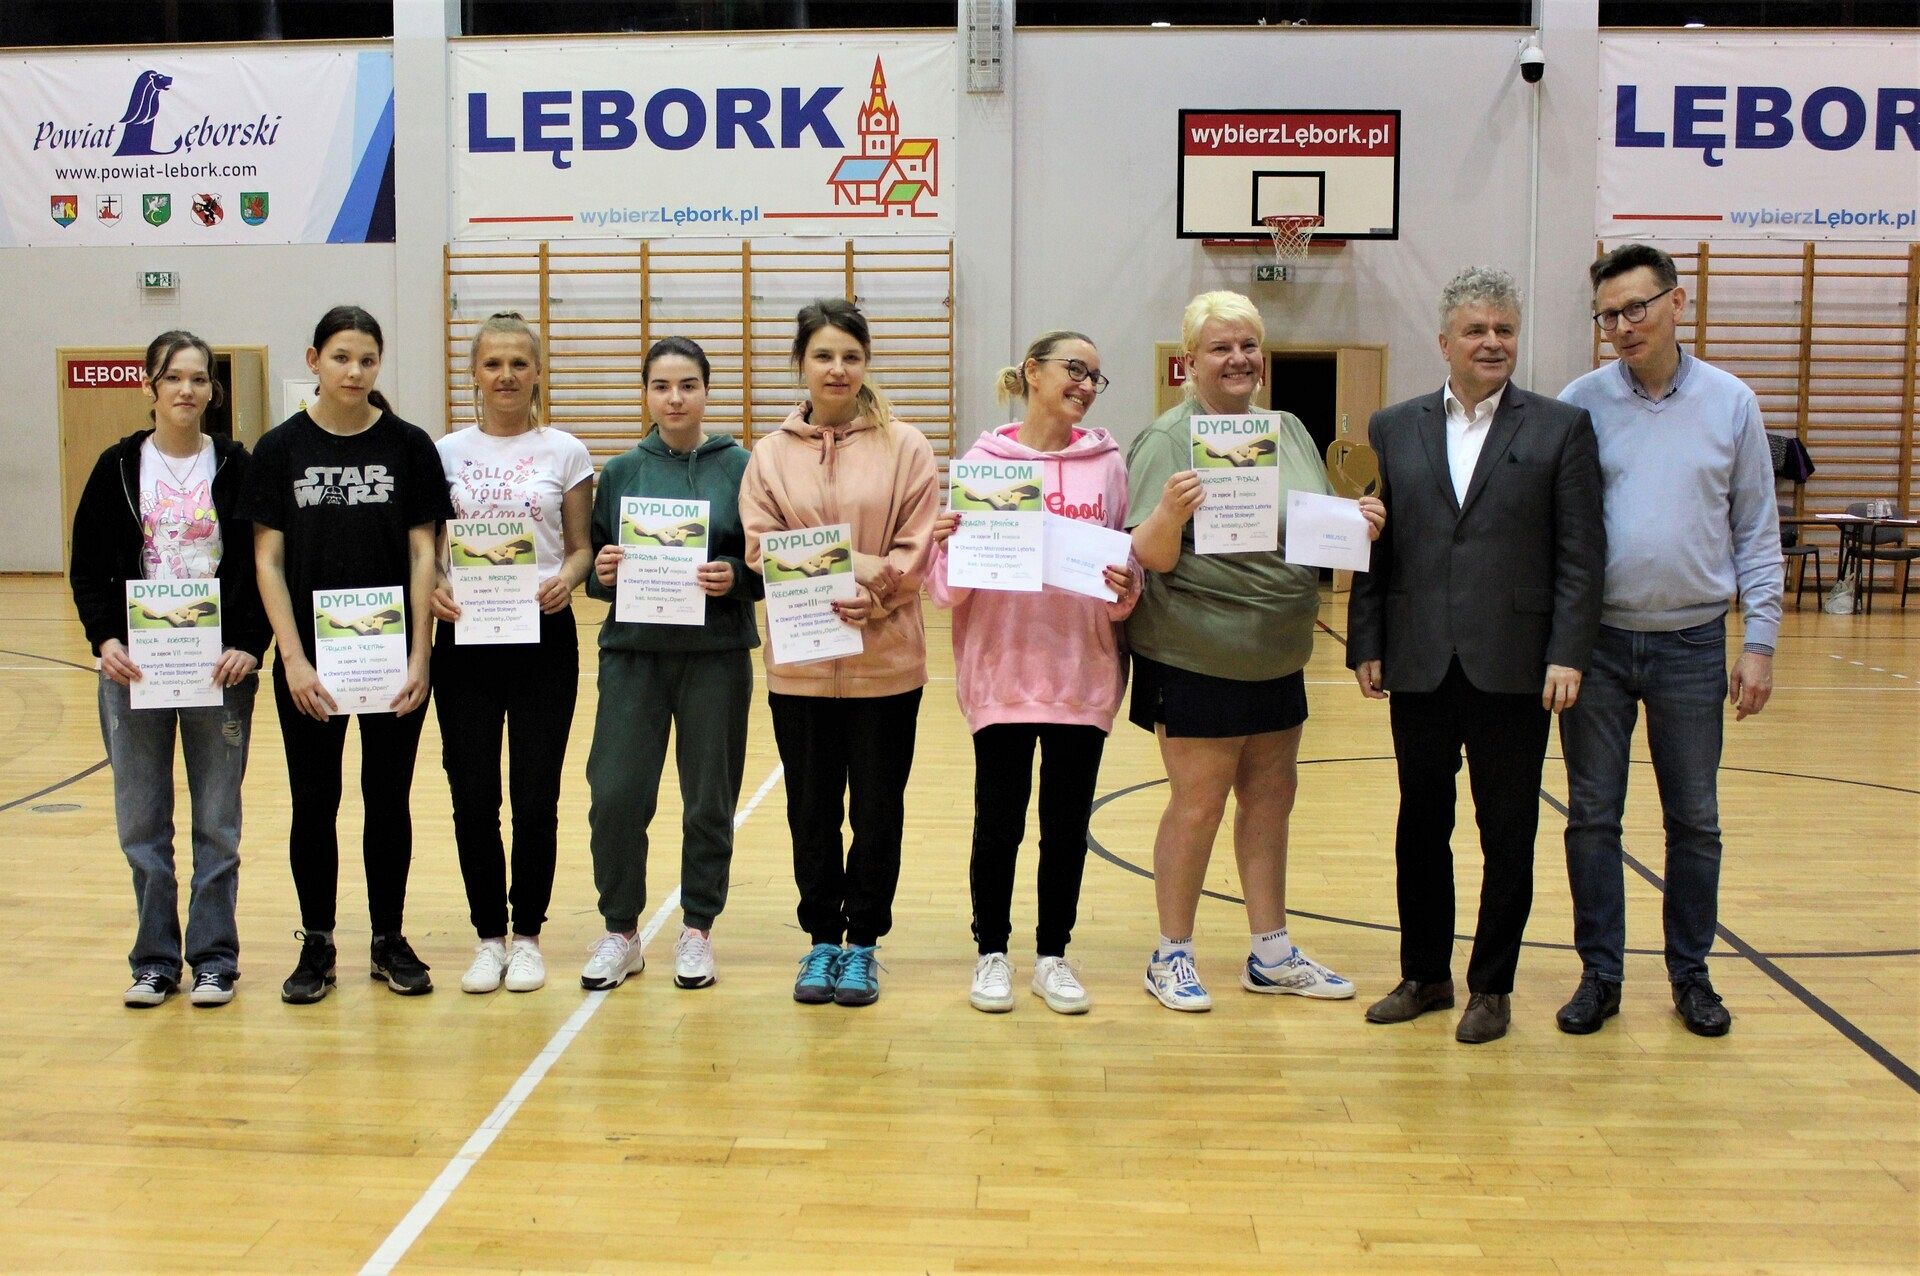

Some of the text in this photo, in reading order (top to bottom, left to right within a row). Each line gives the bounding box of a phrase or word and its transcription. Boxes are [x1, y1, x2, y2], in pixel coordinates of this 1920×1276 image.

[33, 120, 116, 152] Powiat
[468, 87, 844, 169] LĘBORK
[1191, 123, 1389, 148] wybierzLębork.pl
[55, 162, 257, 182] www.powiat-lebork.com
[580, 205, 759, 225] wybierzLębork.pl
[1731, 208, 1916, 229] wybierzLębork.pl
[1197, 420, 1269, 435] DYPLOM
[294, 464, 394, 488] STAR
[957, 466, 1033, 479] DYPLOM
[471, 488, 512, 500] YOUR
[628, 502, 699, 518] DYPLOM
[454, 522, 524, 537] DYPLOM
[767, 530, 840, 552] DYPLOM
[134, 584, 209, 598] DYPLOM
[320, 592, 393, 608] DYPLOM
